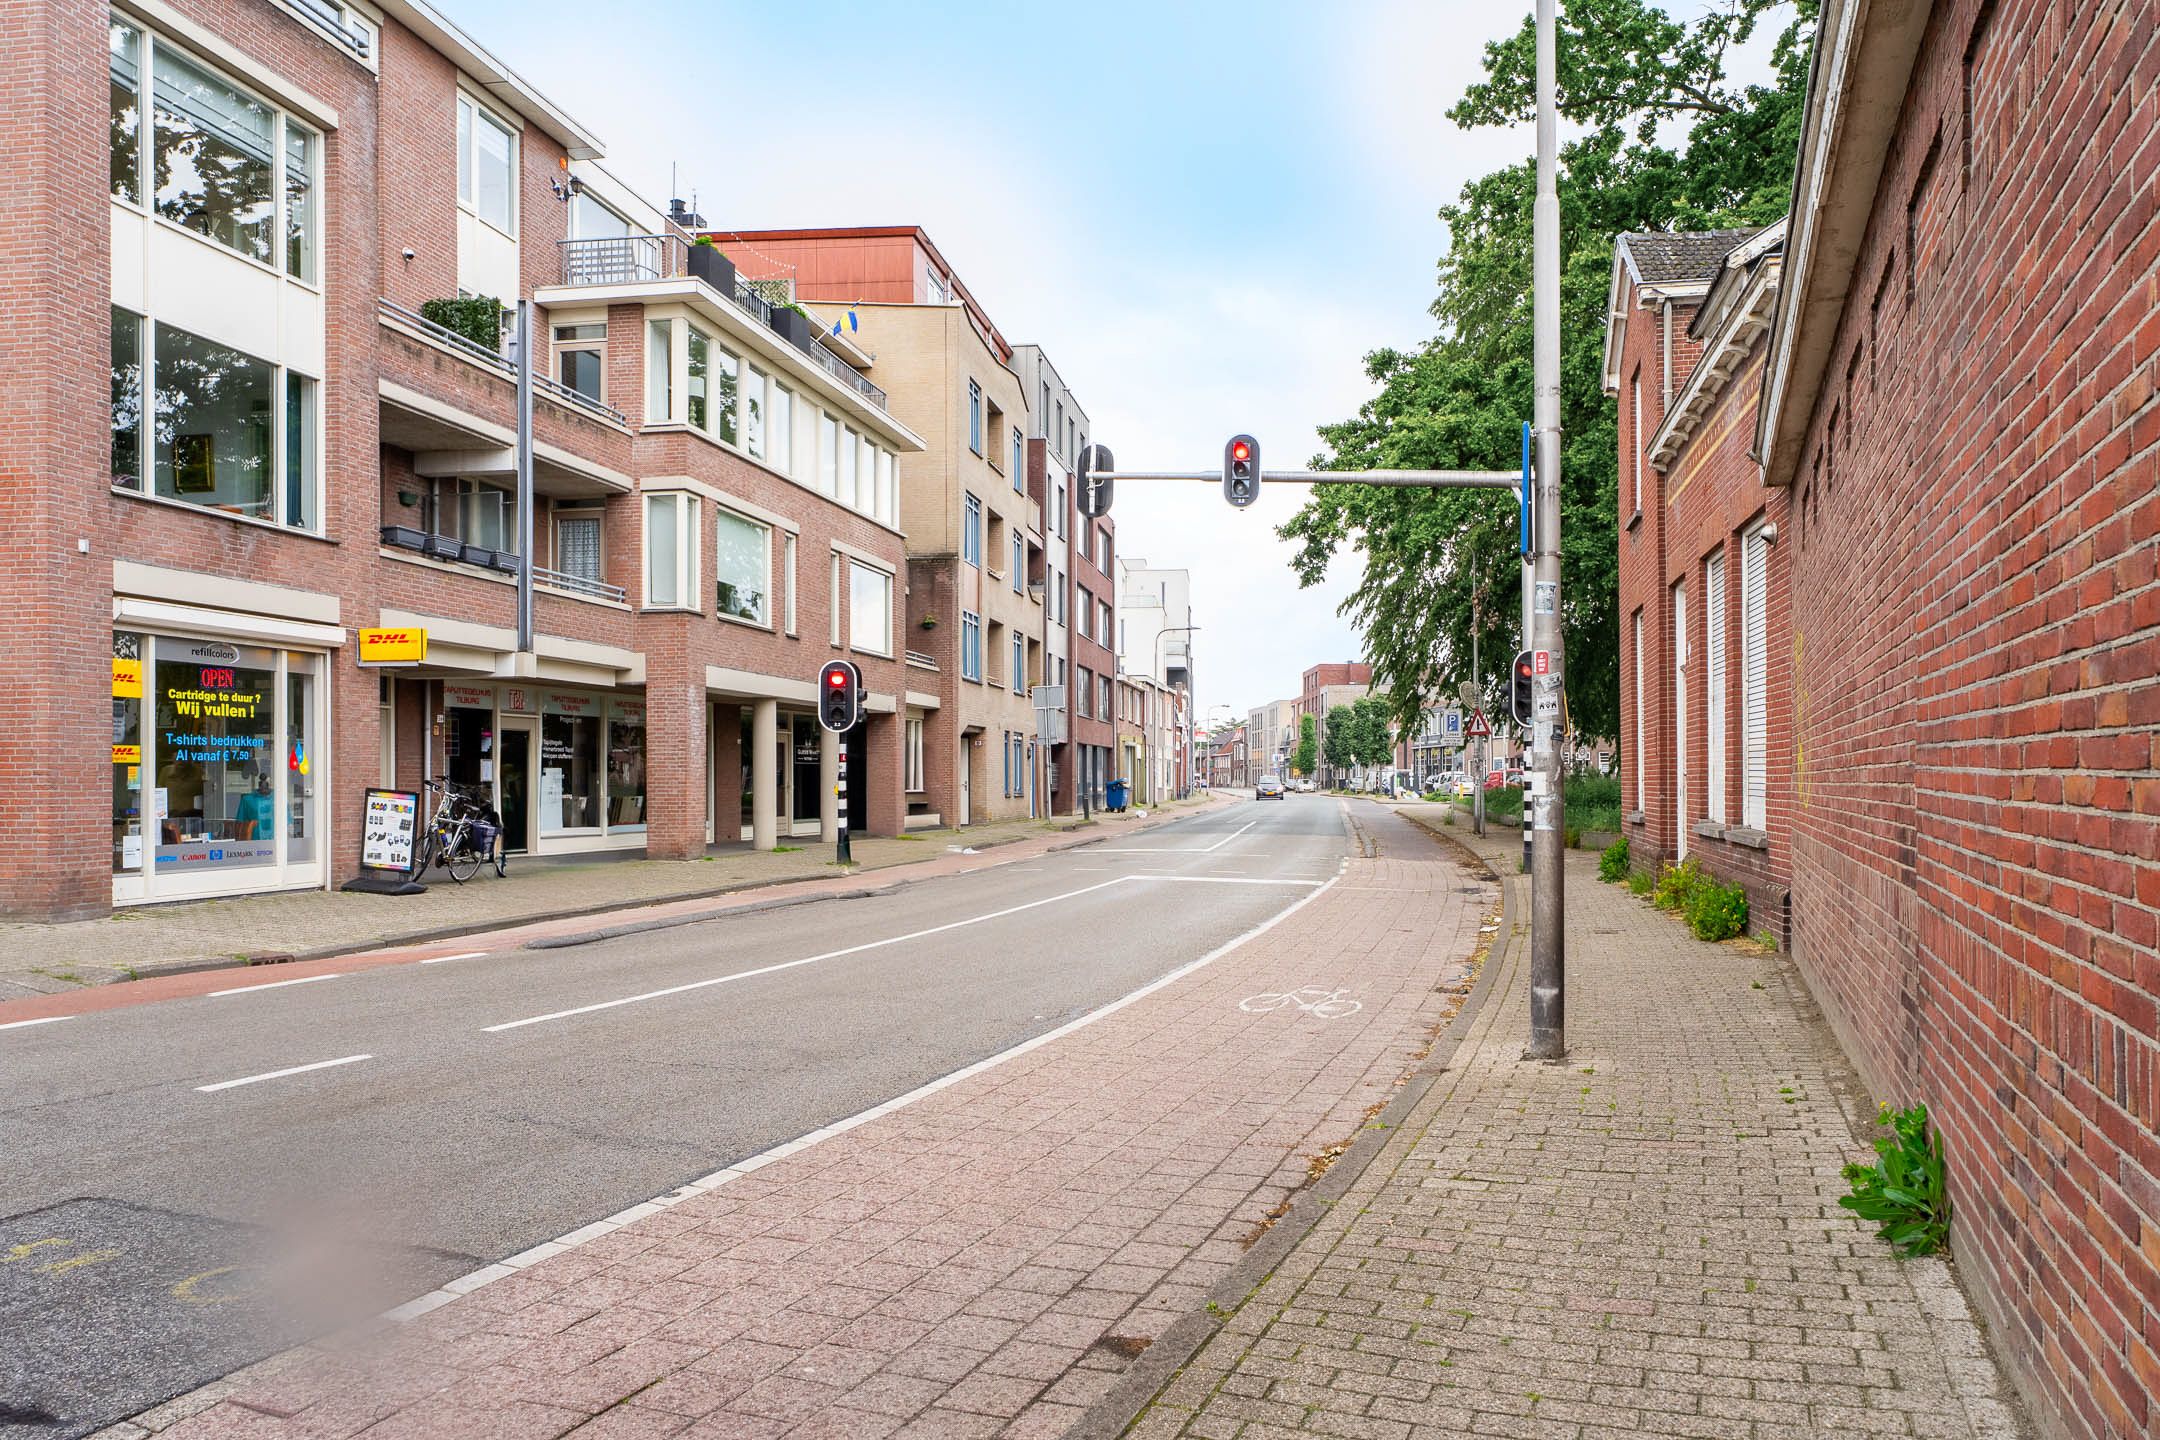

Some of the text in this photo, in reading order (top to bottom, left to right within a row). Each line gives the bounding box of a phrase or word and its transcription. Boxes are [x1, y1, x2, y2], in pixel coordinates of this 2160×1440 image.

[368, 634, 409, 644] DHL
[191, 647, 234, 659] refillcolors
[201, 668, 233, 688] OPEN
[168, 688, 261, 703] Cartridge te duur ?
[176, 701, 255, 718] Wij vullen !
[165, 733, 264, 748] T-shirts bedrukken
[176, 750, 188, 761] Al
[190, 750, 221, 761] vanaf
[231, 750, 249, 761] 7,50
[182, 853, 207, 861] Canon
